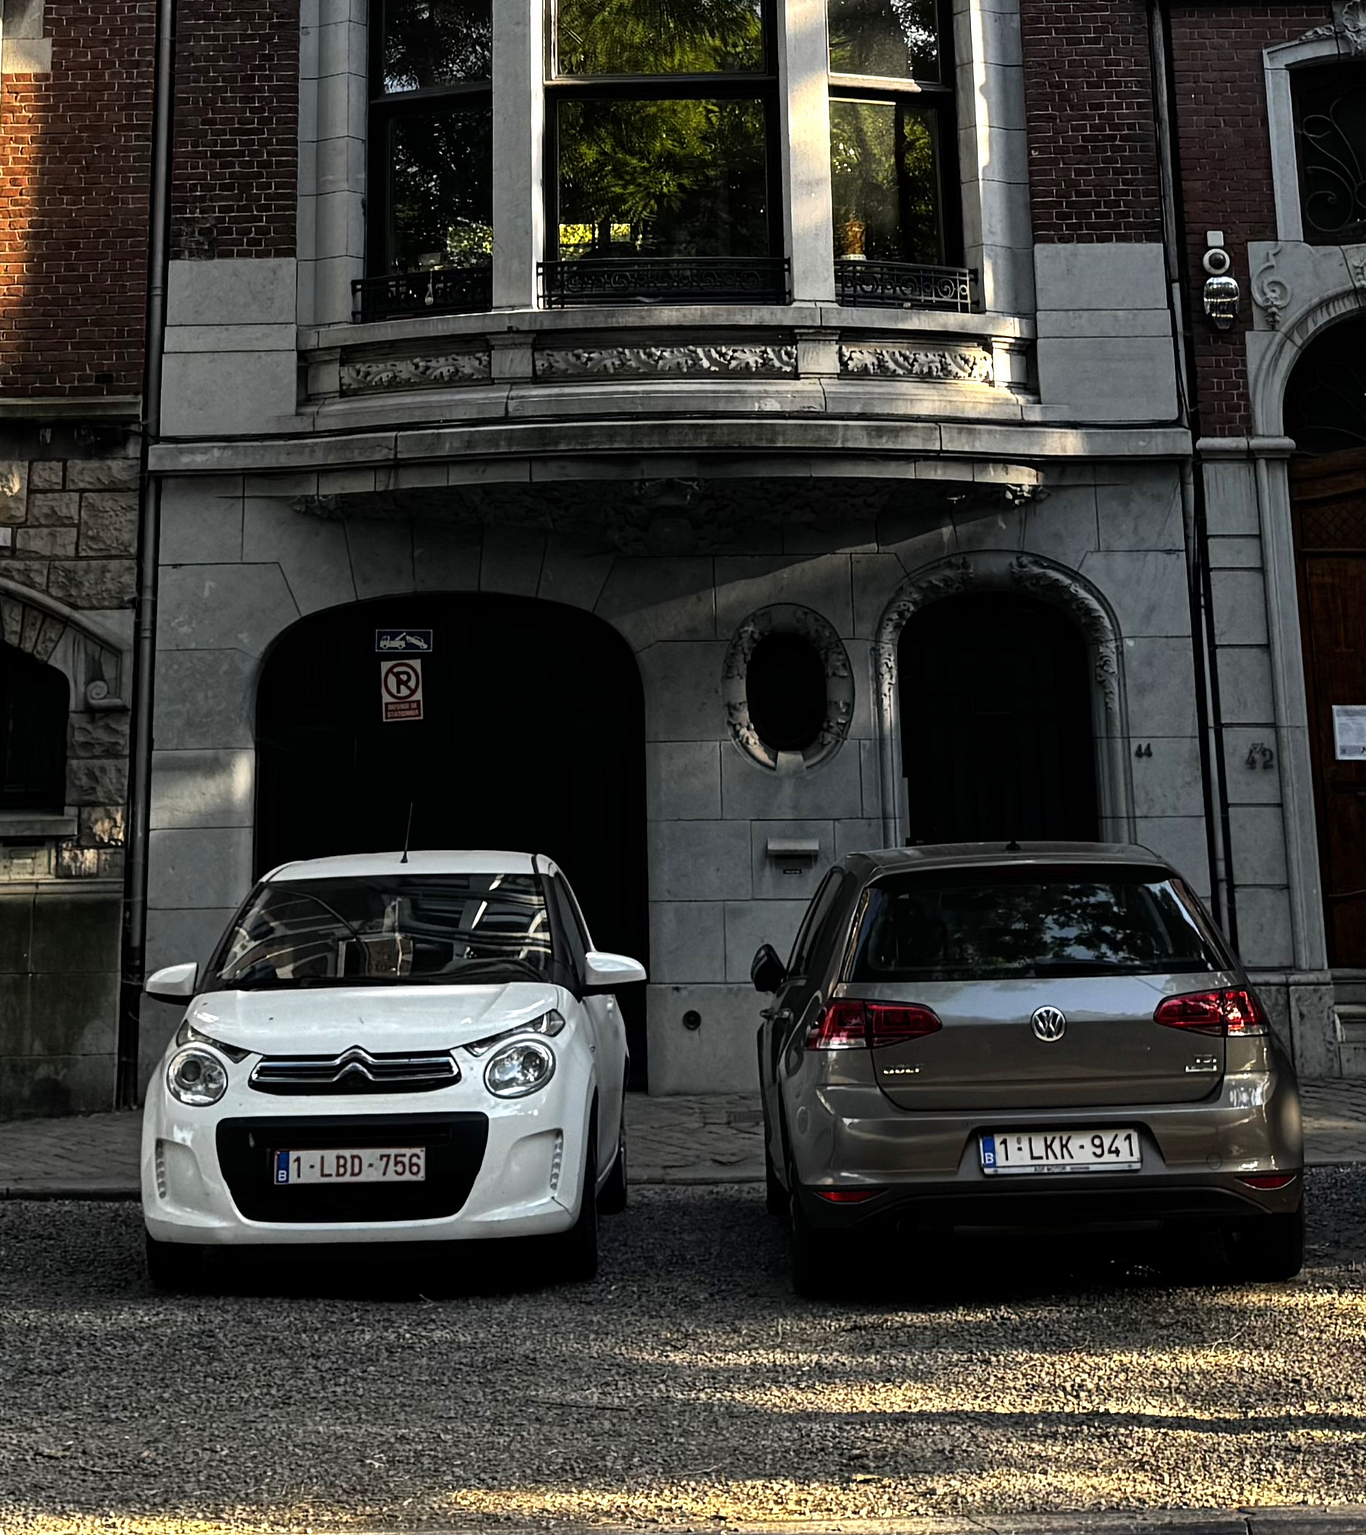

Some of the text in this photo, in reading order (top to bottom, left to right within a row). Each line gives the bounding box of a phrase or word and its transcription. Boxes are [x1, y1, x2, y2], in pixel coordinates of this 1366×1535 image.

[1135, 743, 1153, 758] 44
[985, 1152, 994, 1164] B
[278, 1170, 287, 1181] B
